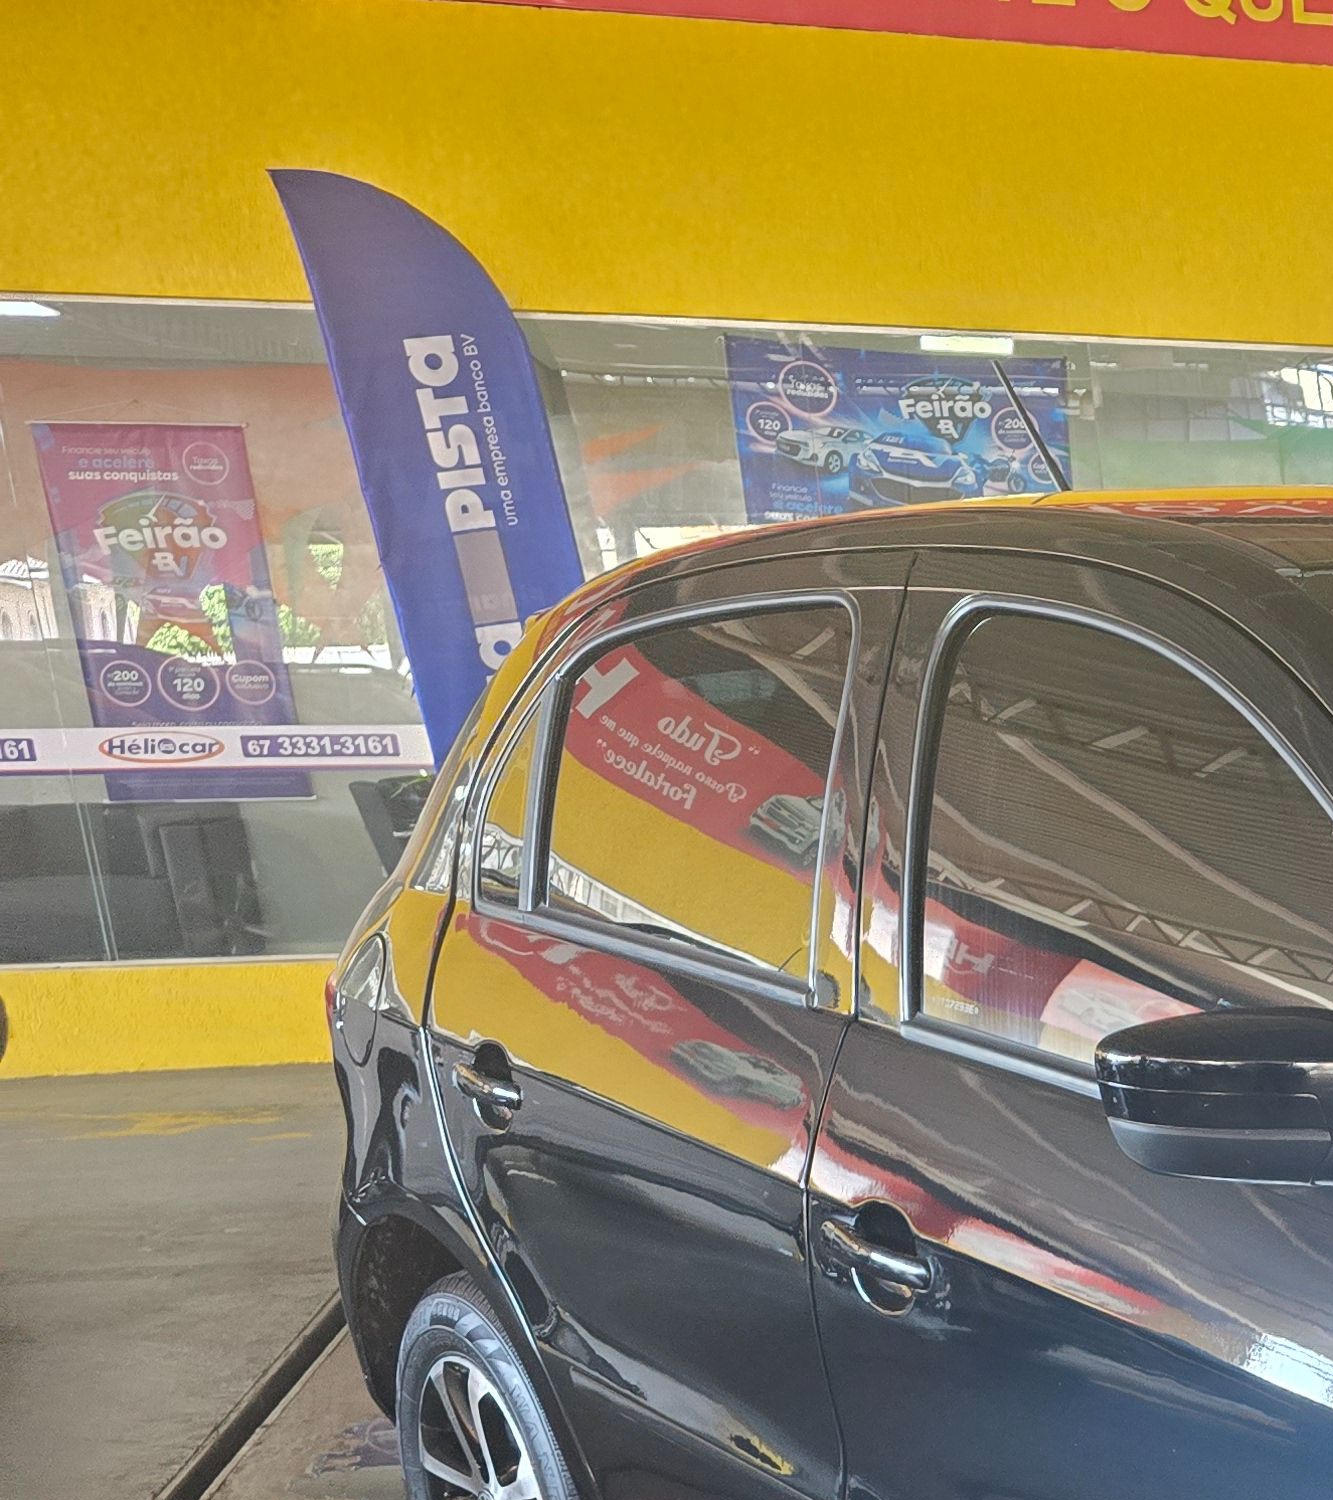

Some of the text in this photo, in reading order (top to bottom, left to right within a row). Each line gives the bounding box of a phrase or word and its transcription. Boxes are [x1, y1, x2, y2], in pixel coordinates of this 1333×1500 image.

[898, 394, 992, 420] Feirão
[460, 334, 518, 525] uma empresa banco BV
[758, 418, 781, 431] 120
[68, 470, 179, 483] suas conquistas
[93, 516, 228, 555] Feirão
[112, 670, 139, 681] 200
[172, 677, 205, 692] 120
[0, 738, 31, 761] 61
[248, 735, 395, 756] 67 3331-3161
